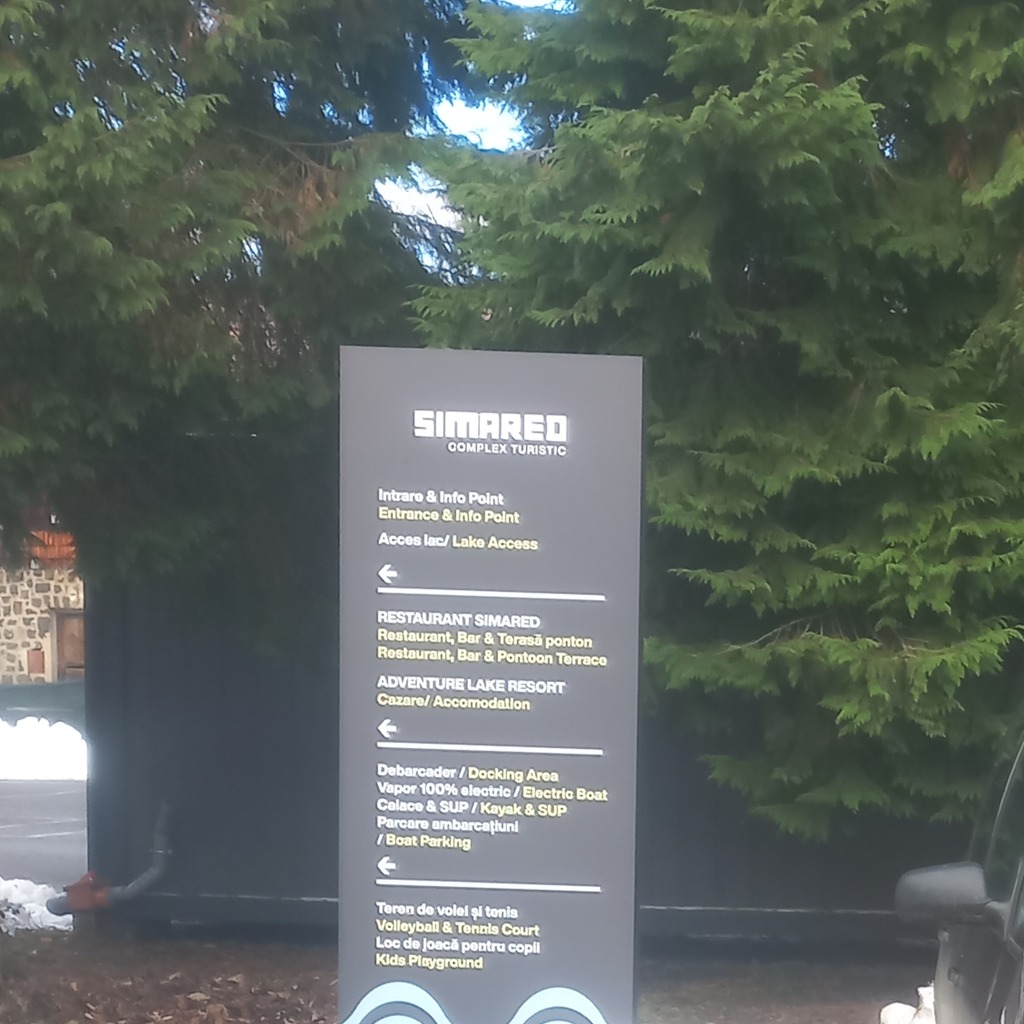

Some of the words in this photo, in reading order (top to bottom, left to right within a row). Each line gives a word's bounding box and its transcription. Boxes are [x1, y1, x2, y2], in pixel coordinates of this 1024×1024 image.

[414, 410, 567, 442] SIMARED
[447, 442, 508, 454] COMPLEX
[510, 444, 567, 456] TURISTIC
[378, 489, 424, 503] Intrare
[426, 490, 436, 503] &
[440, 491, 465, 504] Info
[469, 492, 504, 505] Point
[378, 507, 439, 520] Entrance
[442, 509, 452, 521] &
[456, 510, 482, 522] Info
[485, 510, 519, 523] Point
[378, 532, 421, 546] Acces
[453, 535, 485, 548] Lake
[487, 536, 538, 550] Access
[377, 611, 472, 626] RESTAURANT
[474, 614, 541, 628] SIMARED
[377, 629, 454, 645] Restaurant,
[458, 631, 480, 644] Bar
[484, 632, 494, 645] &
[545, 636, 593, 649] ponton
[377, 646, 454, 662] Restaurant,
[457, 649, 481, 661] Bar
[484, 649, 494, 662] &
[497, 651, 553, 664] Pontoon
[556, 653, 607, 666] Terrace
[377, 676, 465, 690] ADVENTURE
[467, 678, 505, 691] LAKE
[508, 680, 566, 694] RESORT
[377, 693, 429, 707] Cazare/
[433, 695, 531, 710] Accomodation
[377, 764, 456, 778] Debarcader
[459, 767, 466, 778] /
[468, 767, 523, 782] Docking
[527, 769, 559, 782] Area
[377, 782, 417, 796] Vapor
[420, 783, 457, 796] 100%
[461, 785, 511, 797] electric
[513, 786, 521, 798] /
[523, 786, 574, 800] Electric
[576, 788, 608, 801] Boat
[426, 800, 437, 813] &
[440, 800, 469, 813] SUP
[471, 803, 478, 814] /
[480, 803, 522, 817] Kayak
[525, 804, 535, 816] &
[538, 804, 567, 817] SUP
[377, 816, 429, 830] Parcare
[377, 835, 384, 846] /
[385, 834, 418, 847] Boat
[420, 835, 471, 851] Parking
[376, 902, 415, 915] Teren
[417, 903, 434, 916] de
[437, 905, 469, 917] volei
[485, 906, 518, 919] tenis
[376, 919, 440, 935] Volleyball
[442, 921, 452, 934] &
[455, 922, 499, 935] Tennis
[502, 923, 540, 936] Court
[376, 936, 400, 949] Loc
[403, 937, 421, 950] de
[423, 937, 459, 952] joacă
[462, 940, 505, 954] pentru
[508, 941, 540, 956] copii
[376, 953, 406, 966] Kids
[408, 954, 484, 970] Playground
